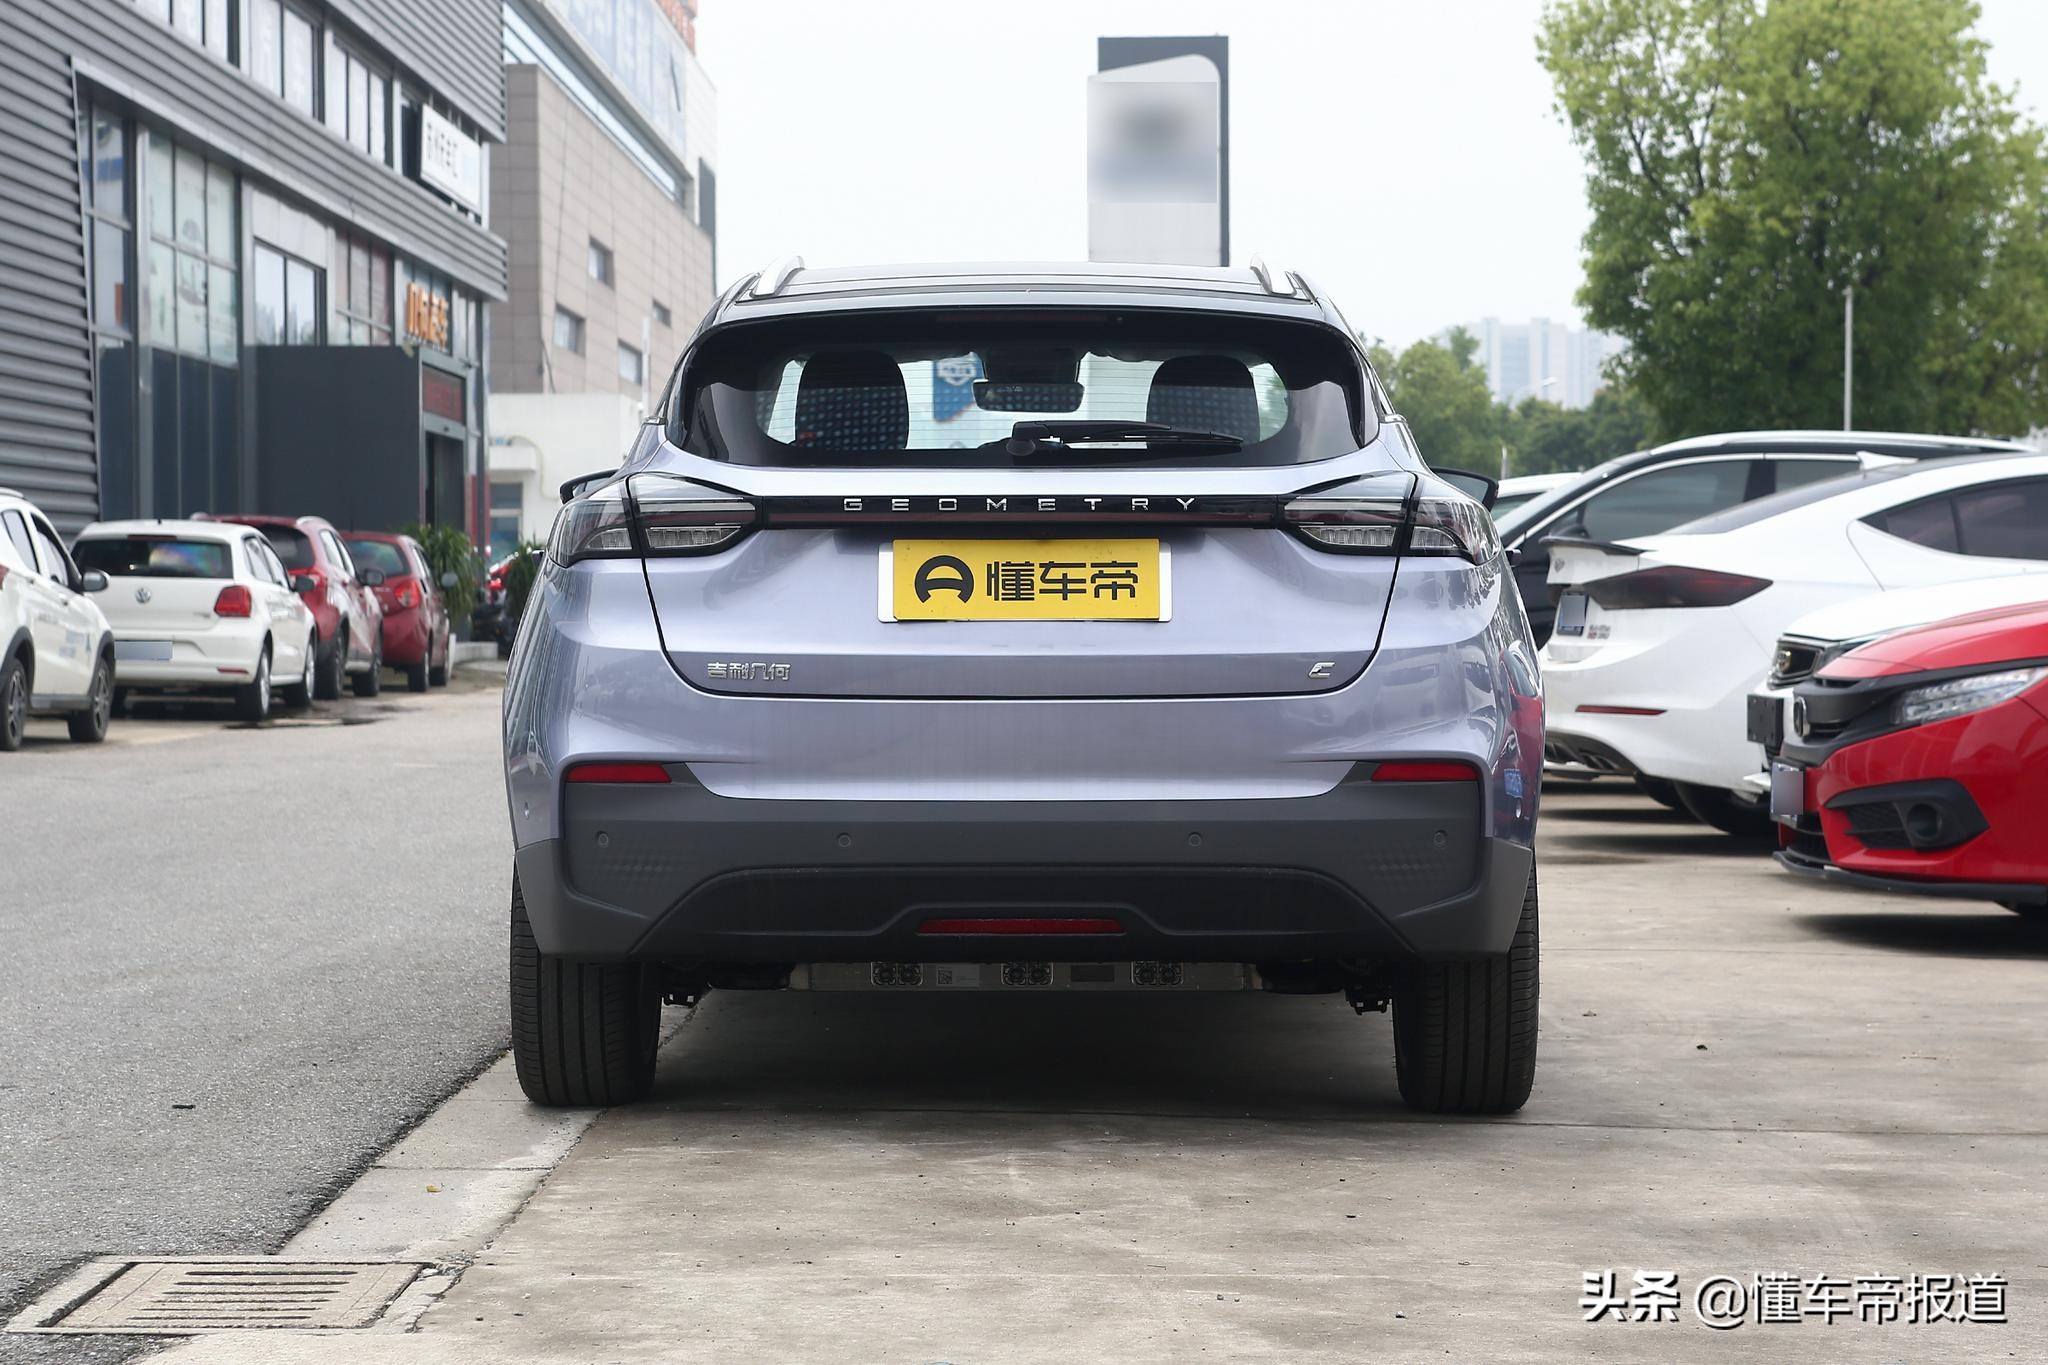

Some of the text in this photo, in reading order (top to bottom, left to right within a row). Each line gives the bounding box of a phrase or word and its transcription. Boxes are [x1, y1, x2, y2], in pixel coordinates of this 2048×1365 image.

[843, 498, 1195, 511] GEOMETRY
[986, 560, 1139, 602] 懂车帝
